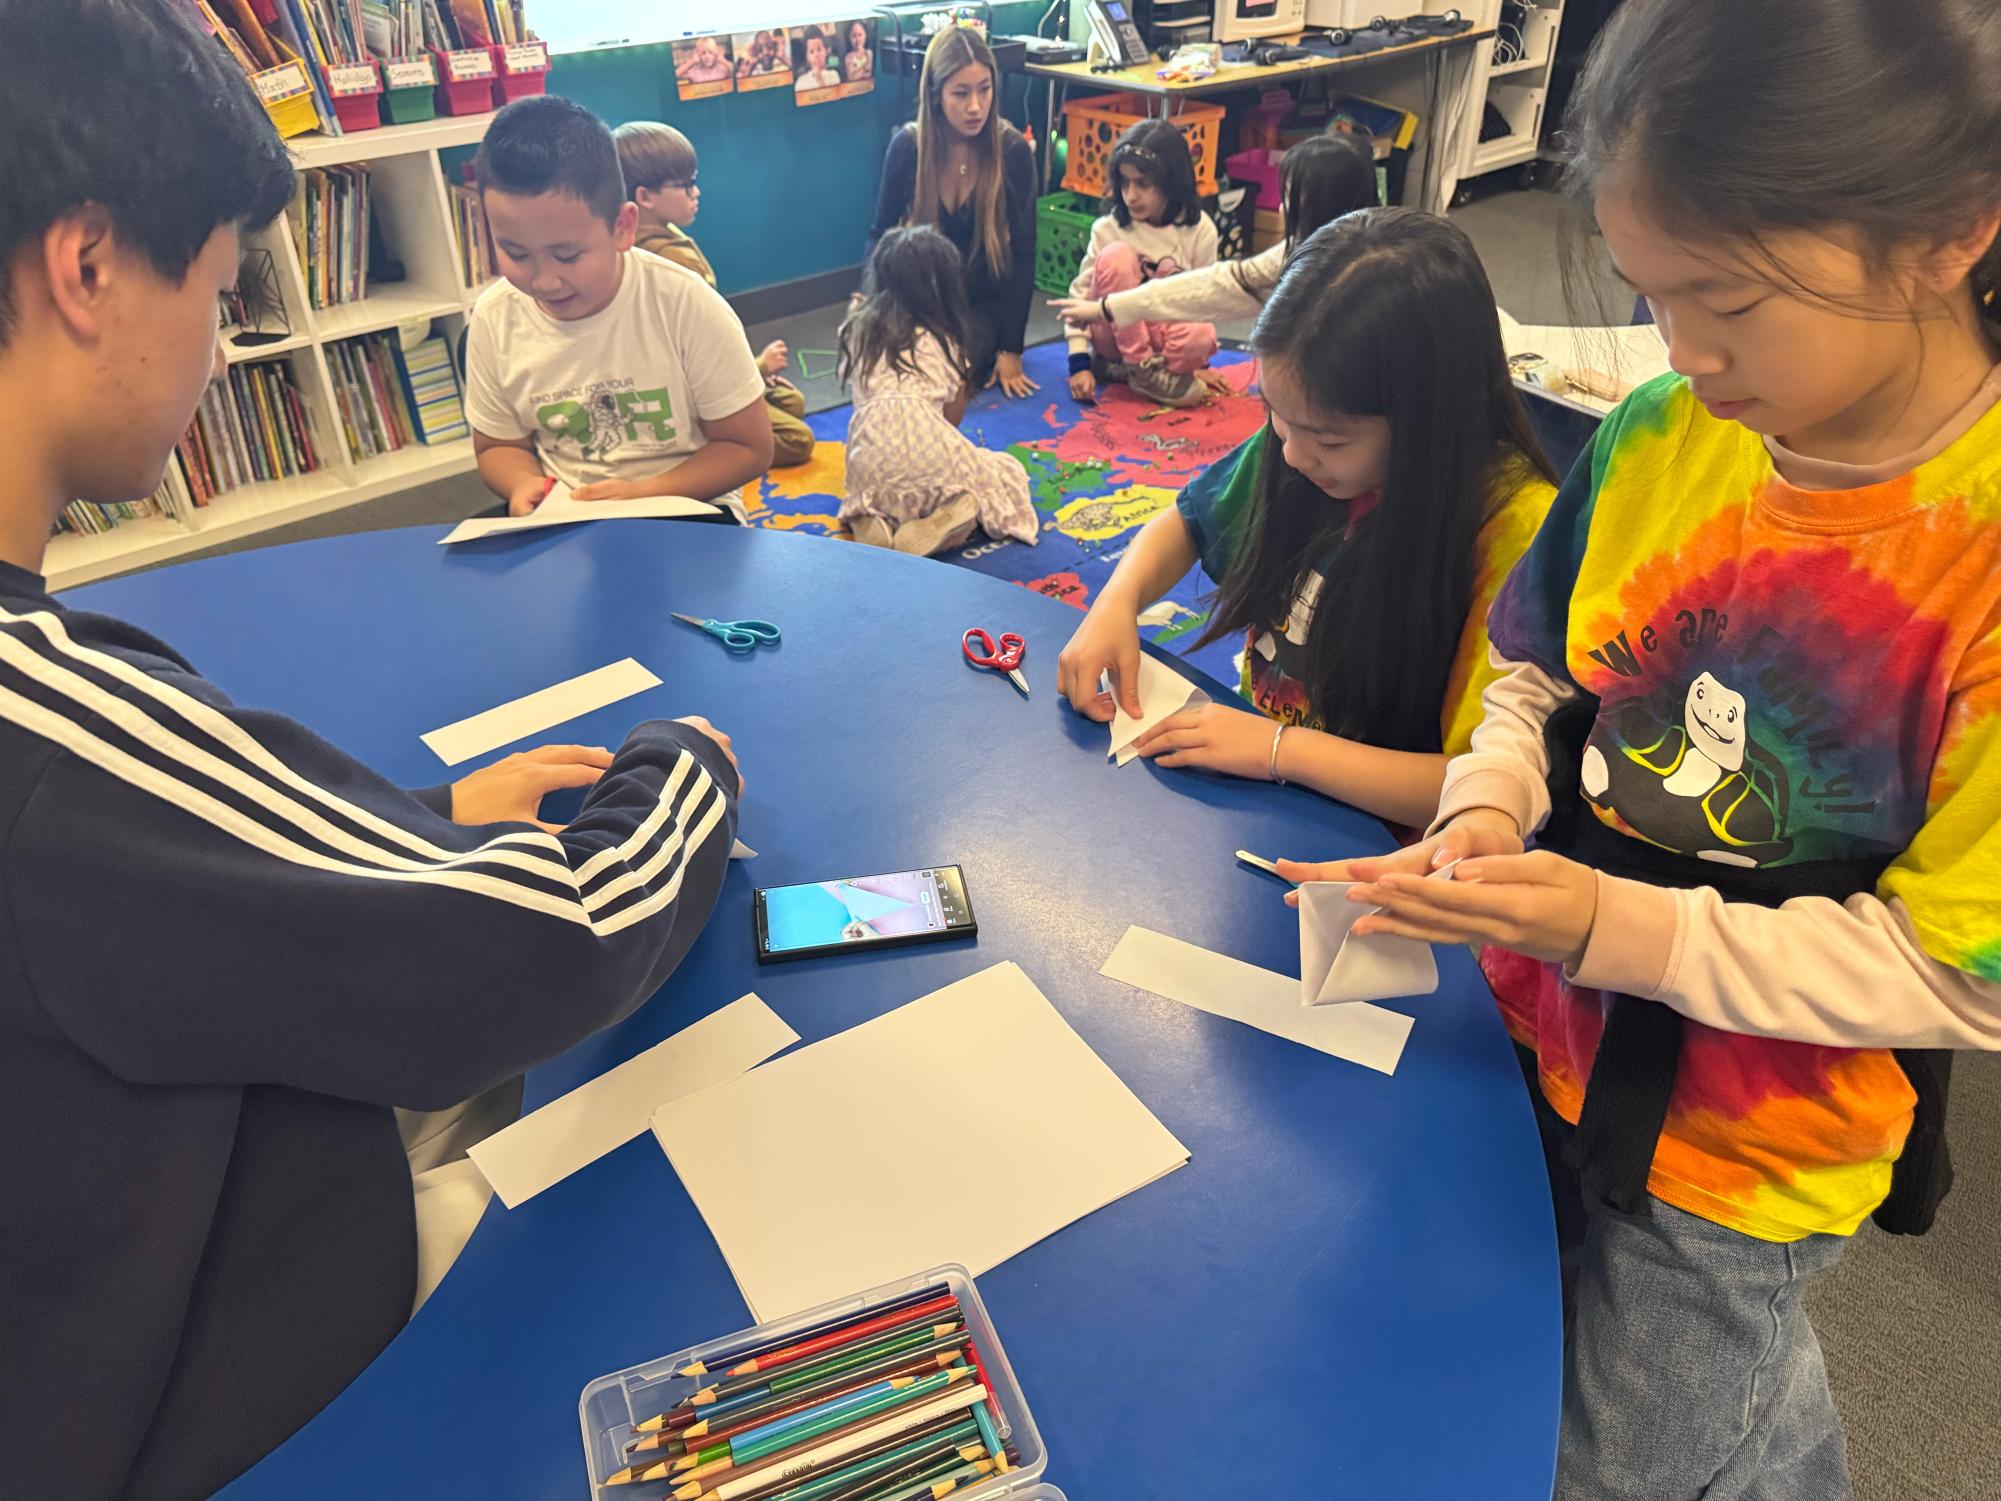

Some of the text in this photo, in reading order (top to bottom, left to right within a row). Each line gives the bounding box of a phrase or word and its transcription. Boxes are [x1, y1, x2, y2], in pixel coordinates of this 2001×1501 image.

[552, 387, 583, 401] SPACE
[1122, 506, 1157, 522] Africa
[1588, 624, 1658, 678] We
[1675, 607, 1729, 650] are
